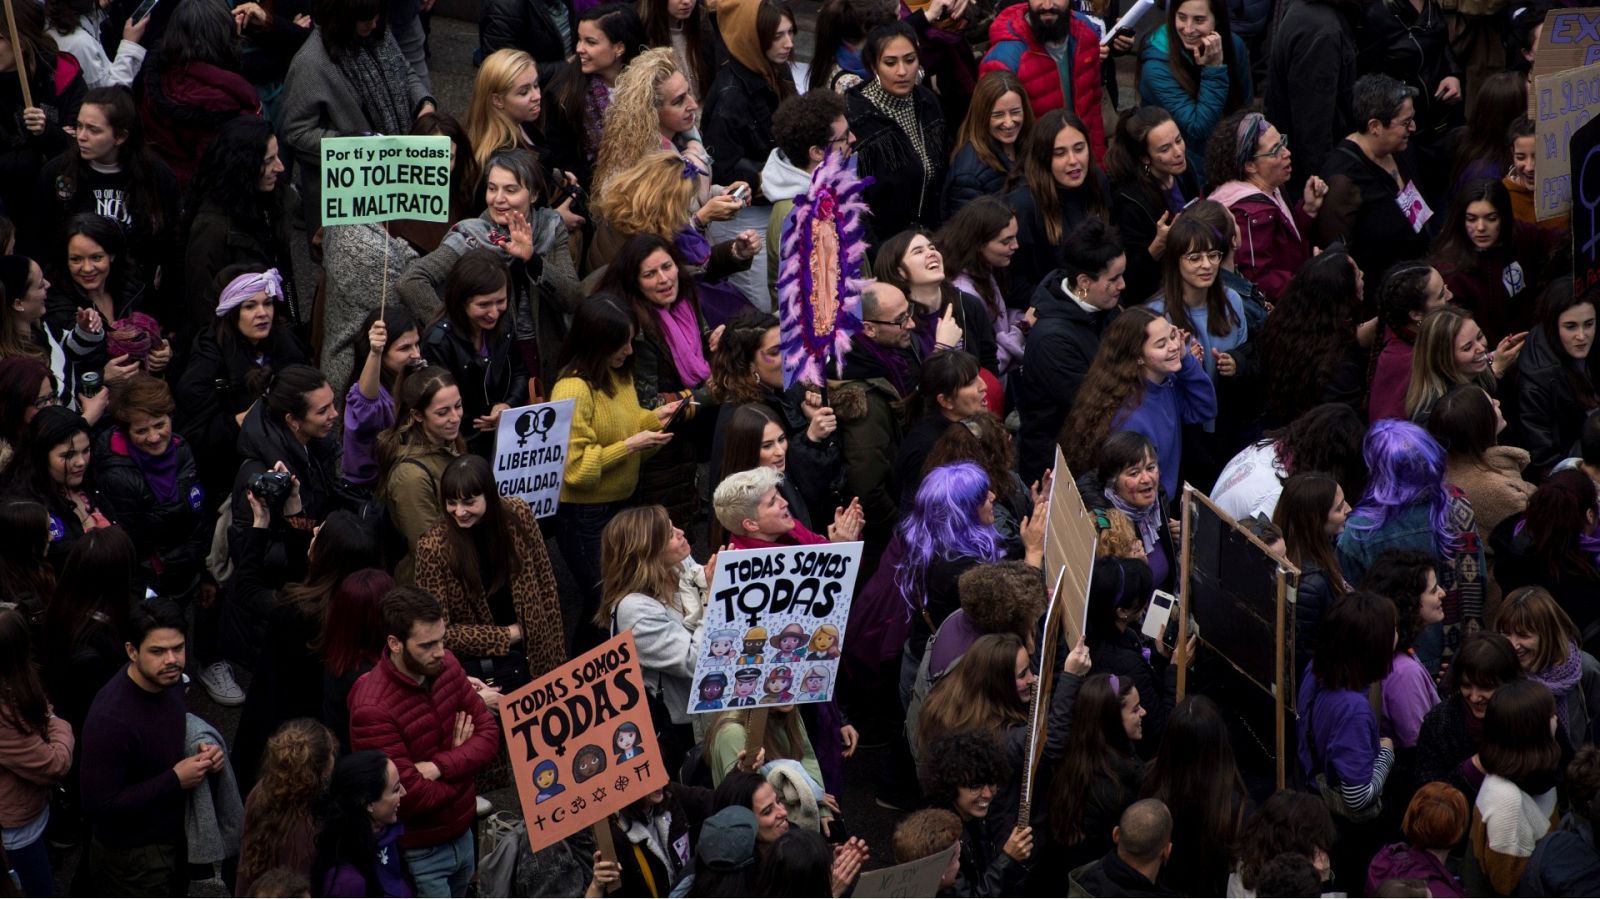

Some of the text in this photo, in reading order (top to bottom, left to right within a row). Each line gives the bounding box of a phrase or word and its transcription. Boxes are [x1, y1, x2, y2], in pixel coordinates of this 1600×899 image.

[326, 149, 350, 161] Por
[367, 150, 375, 161] y
[379, 148, 402, 160] por
[406, 147, 449, 159] todas:
[1544, 132, 1557, 160] YA
[327, 164, 448, 188] NO TOLERES
[326, 193, 447, 218] EL MALTRATO.
[498, 444, 564, 471] LIBERTAD,
[528, 498, 555, 516] TAD.
[725, 551, 851, 585] TODAS SOMOS
[715, 577, 842, 627] TODAS
[506, 642, 630, 722] TODAS SOMOS
[511, 667, 640, 762] TODAS
